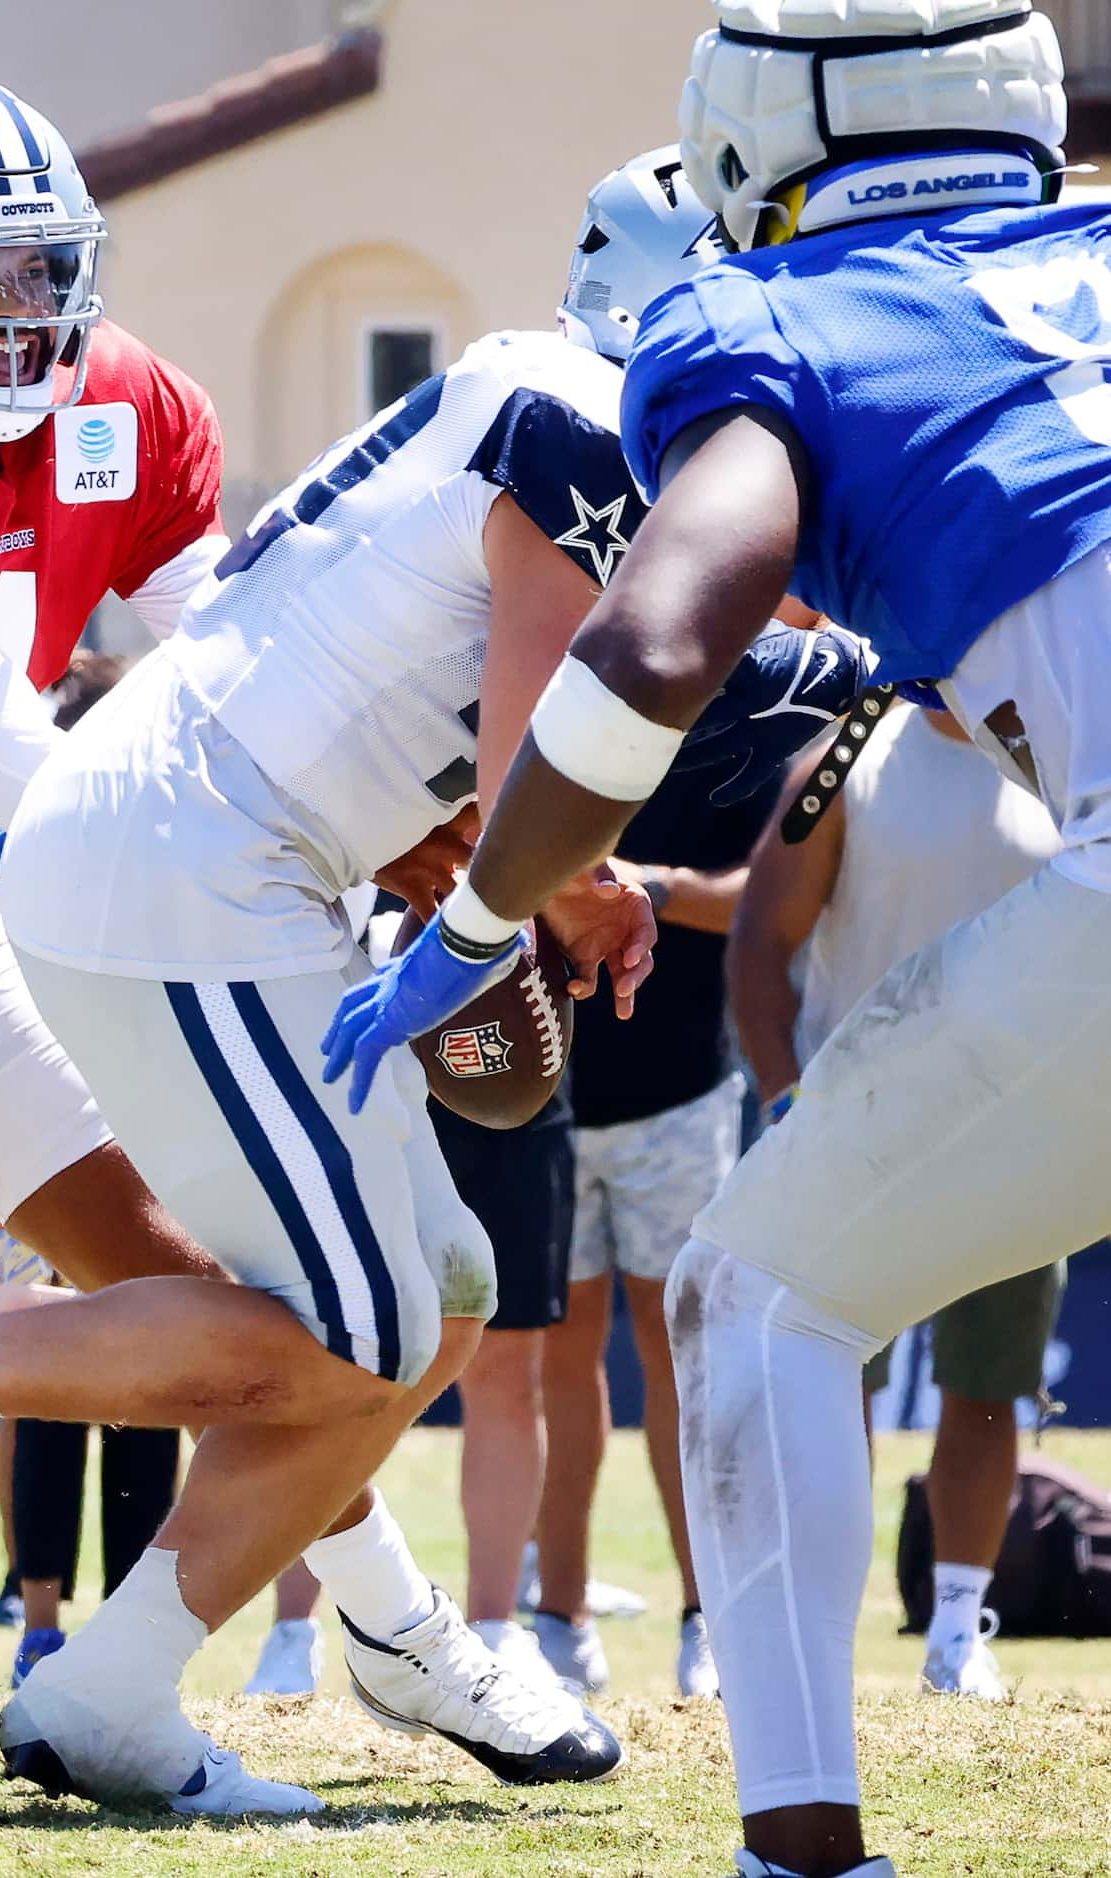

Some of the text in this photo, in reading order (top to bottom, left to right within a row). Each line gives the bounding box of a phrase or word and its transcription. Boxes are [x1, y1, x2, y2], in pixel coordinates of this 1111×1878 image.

[848, 172, 1029, 205] LOS ANGELES
[1, 202, 55, 216] COWBOYS
[74, 469, 120, 491] AT&T
[447, 1034, 481, 1073] NFL
